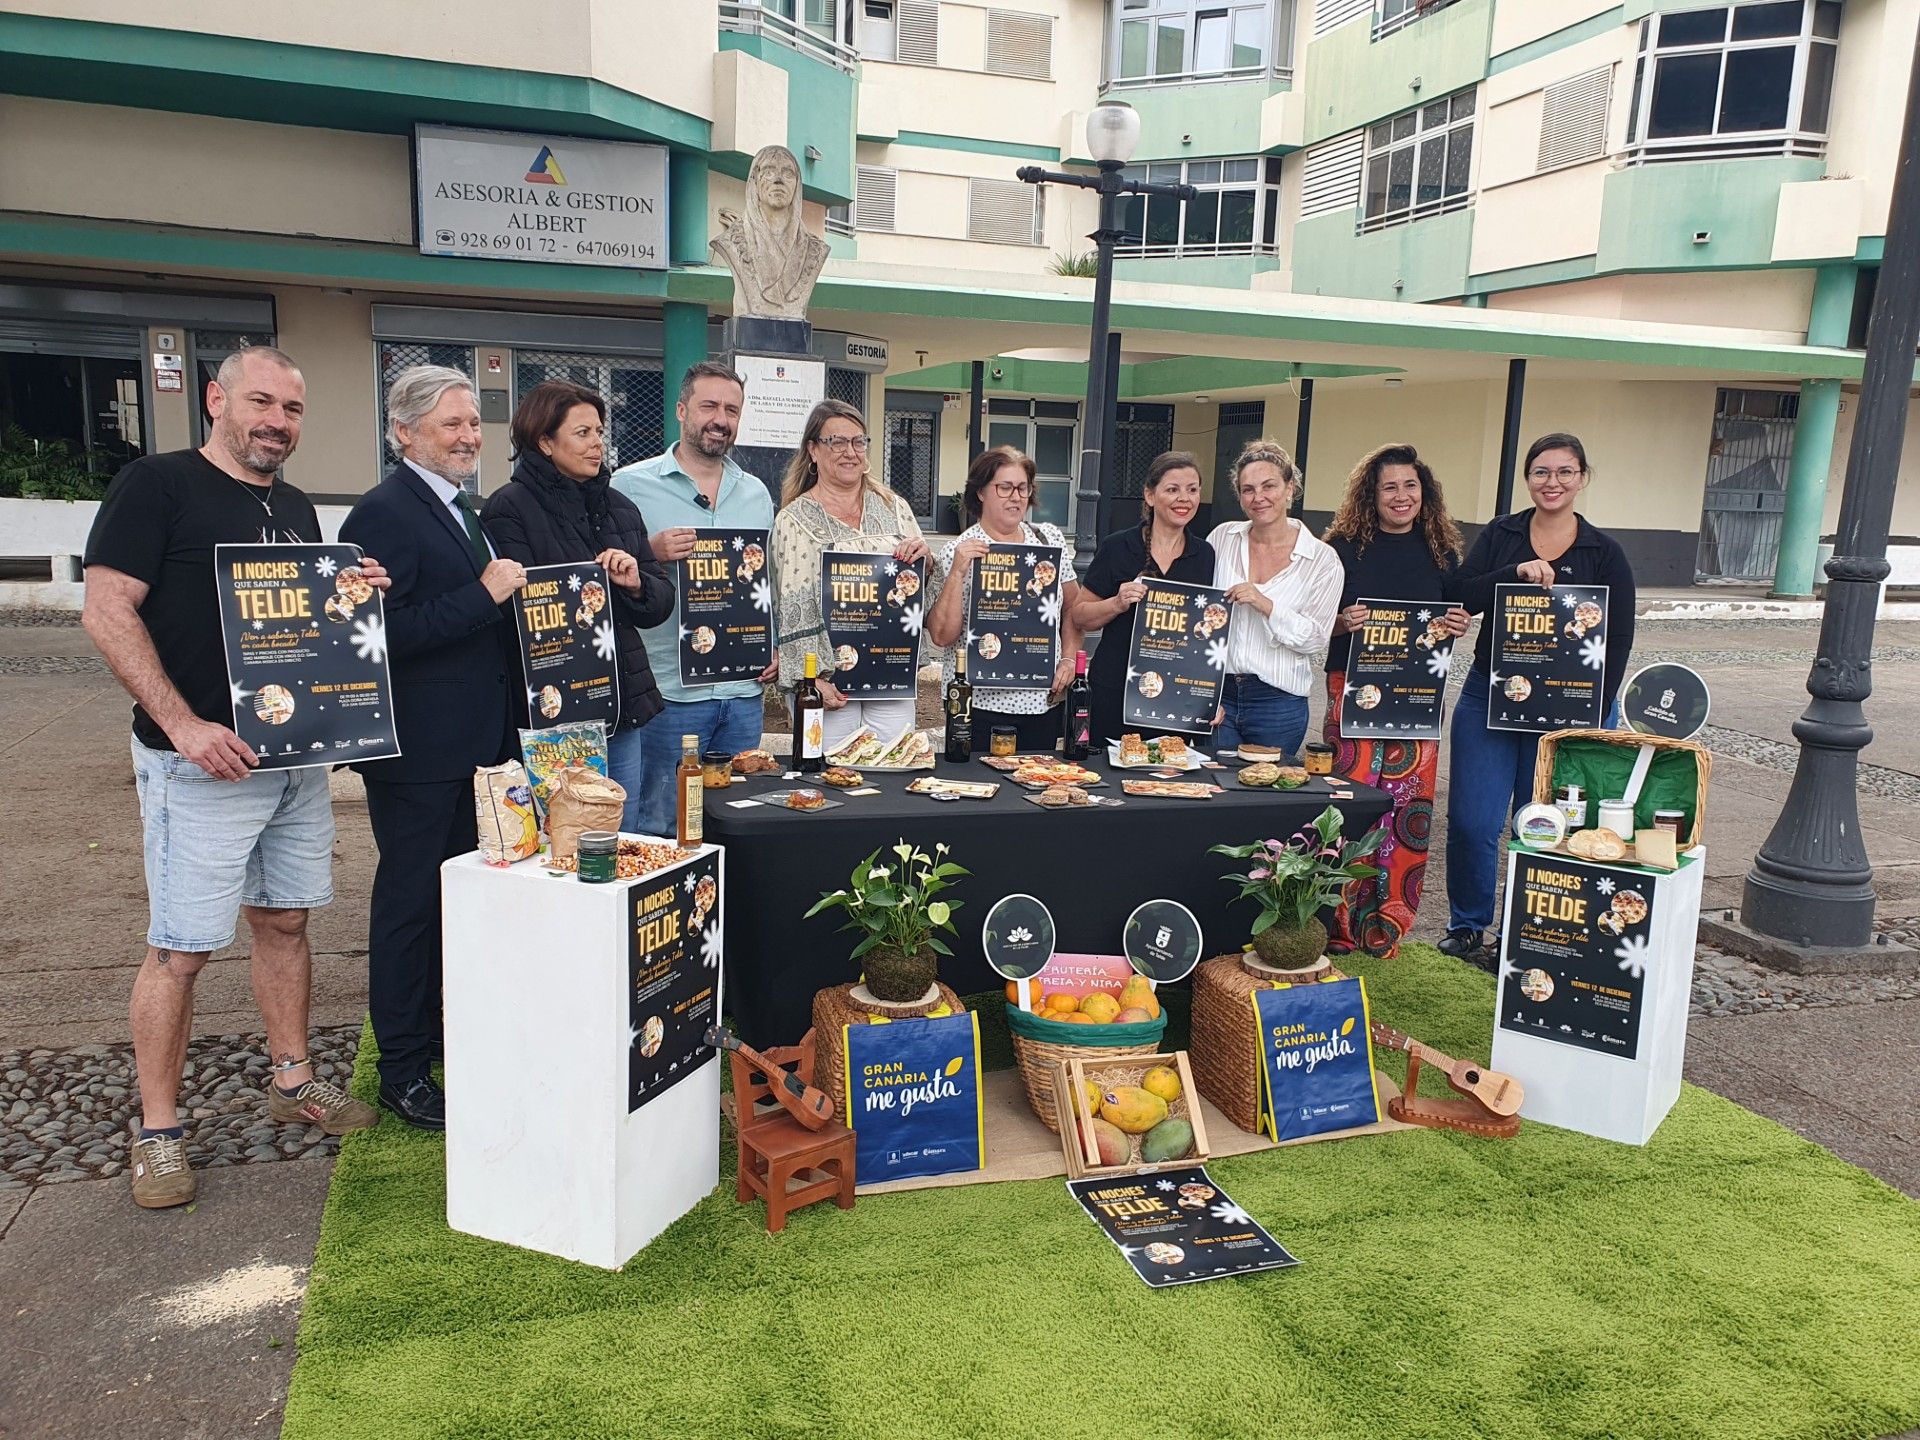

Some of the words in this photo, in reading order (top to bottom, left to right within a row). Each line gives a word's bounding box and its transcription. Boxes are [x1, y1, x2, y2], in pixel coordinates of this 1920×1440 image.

[434, 181, 538, 206] ASESORIA
[545, 190, 561, 207] &
[567, 191, 654, 214] GESTION
[507, 212, 587, 234] ALBERT
[460, 232, 488, 248] 928
[492, 235, 510, 249] 69
[516, 236, 532, 250] 01
[539, 238, 556, 252] 72
[576, 240, 655, 260] 647069194
[848, 343, 886, 360] GESTORÍA
[694, 540, 723, 552] NOCHES
[987, 553, 1016, 566] NOCHES
[232, 562, 242, 580] II
[244, 562, 298, 579] NOCHES
[686, 558, 730, 580] TELDE
[831, 563, 837, 574] II
[838, 564, 873, 576] NOCHES
[234, 580, 252, 588] QUE
[253, 580, 280, 588] SABEN
[528, 580, 559, 598] NOCHES
[981, 570, 1019, 592] TELDE
[831, 582, 879, 603] TELDE
[1154, 592, 1185, 606] NOCHES
[234, 588, 312, 619] TELDE
[1506, 596, 1512, 606] II
[1512, 596, 1550, 608] NOCHES
[524, 603, 568, 632] TELDE
[1144, 608, 1188, 632] TELDE
[1372, 610, 1406, 621] NOCHES
[1505, 613, 1555, 634] TELDE
[301, 628, 320, 638] Telde
[1363, 626, 1409, 646] TELDE
[1648, 706, 1668, 715] Cabildo
[1658, 714, 1678, 724] Canaria
[1526, 882, 1540, 890] QUE
[1541, 885, 1562, 894] SABEN
[1527, 868, 1534, 882] II
[1536, 869, 1581, 890] NOCHES
[644, 885, 674, 914] NOCHES
[1525, 890, 1586, 924] TELDE
[638, 909, 681, 956] TELDE
[1044, 965, 1107, 976] FRUTERÍA
[1091, 979, 1122, 988] NIRA
[1273, 1023, 1305, 1036] GRAN
[1274, 1032, 1327, 1048] CANARIA
[1276, 1050, 1302, 1070] me
[1305, 1028, 1356, 1074] gusta
[864, 1062, 903, 1076] GRAN
[864, 1072, 928, 1088] CANARIA
[865, 1091, 896, 1112] me
[900, 1068, 962, 1117] gusta
[1088, 1191, 1097, 1200] II
[1098, 1186, 1145, 1199] NOCHES
[1098, 1197, 1169, 1218] TELDE
